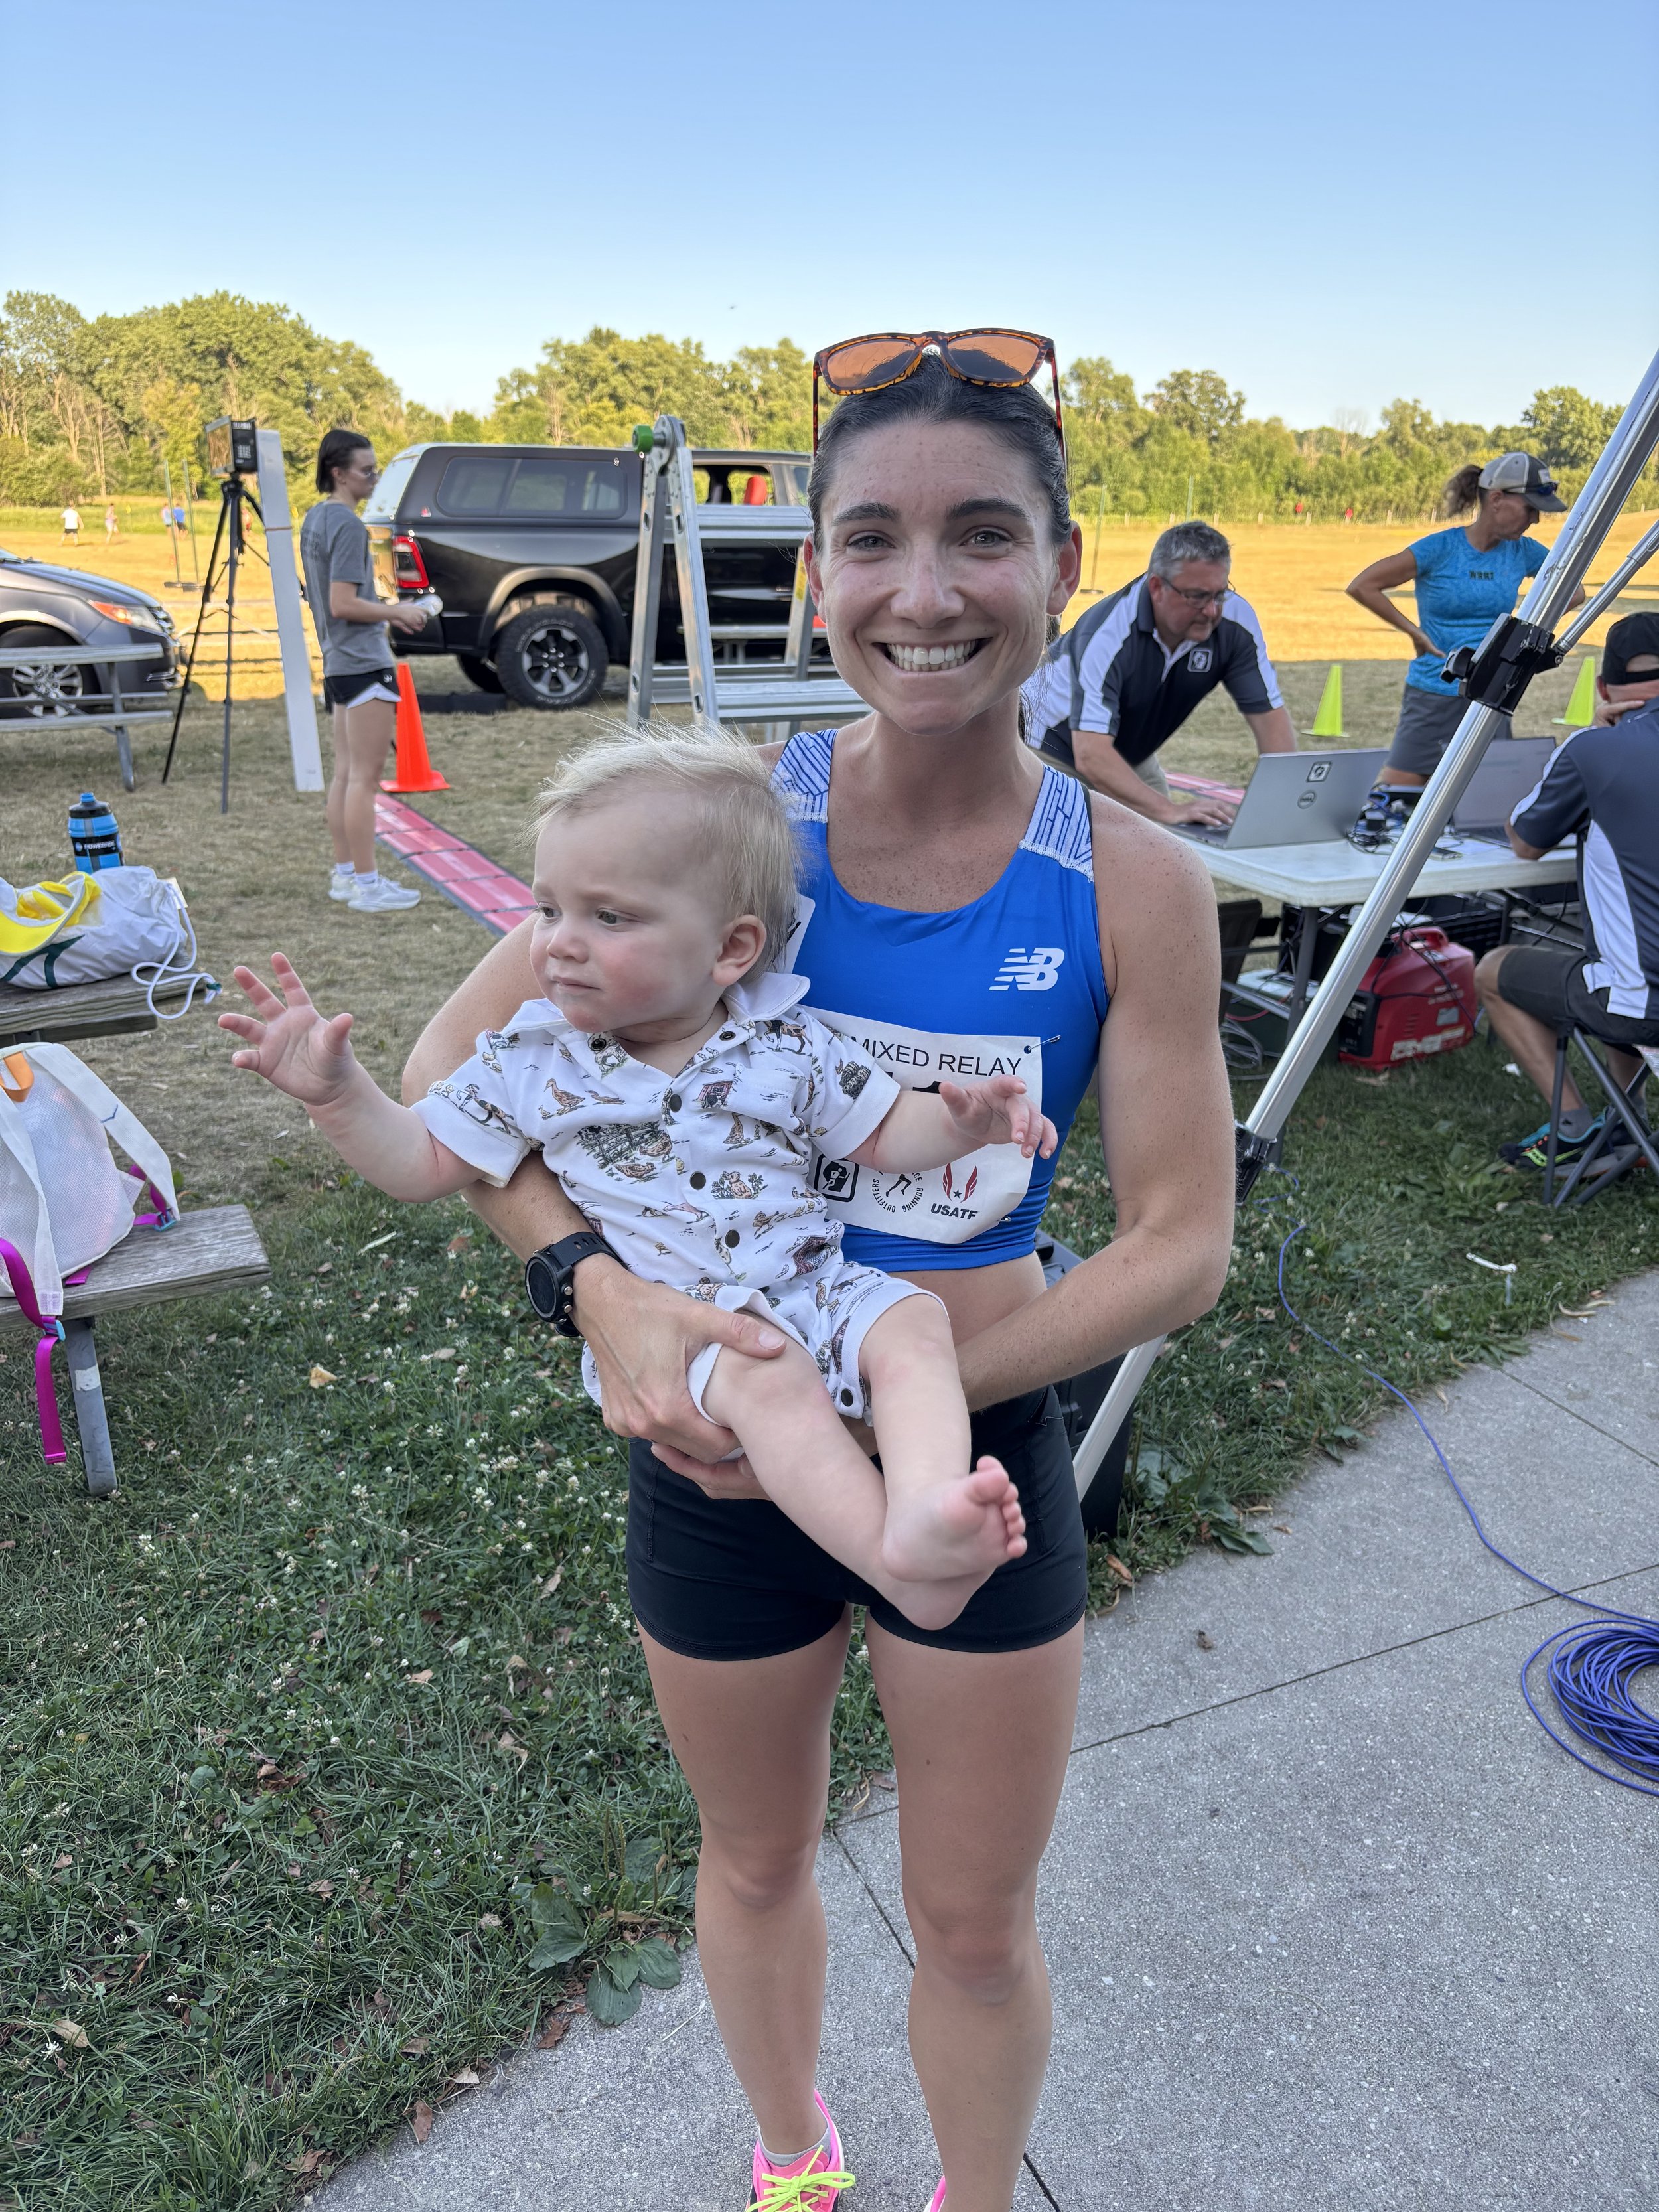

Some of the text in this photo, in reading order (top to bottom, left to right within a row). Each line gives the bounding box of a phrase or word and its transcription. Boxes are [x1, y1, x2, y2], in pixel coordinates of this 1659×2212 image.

[989, 948, 1065, 991] NB
[938, 1053, 1022, 1076] RELAY
[872, 1179, 924, 1213] RUNNING OUTFITTERS
[930, 1203, 978, 1220] USATF
